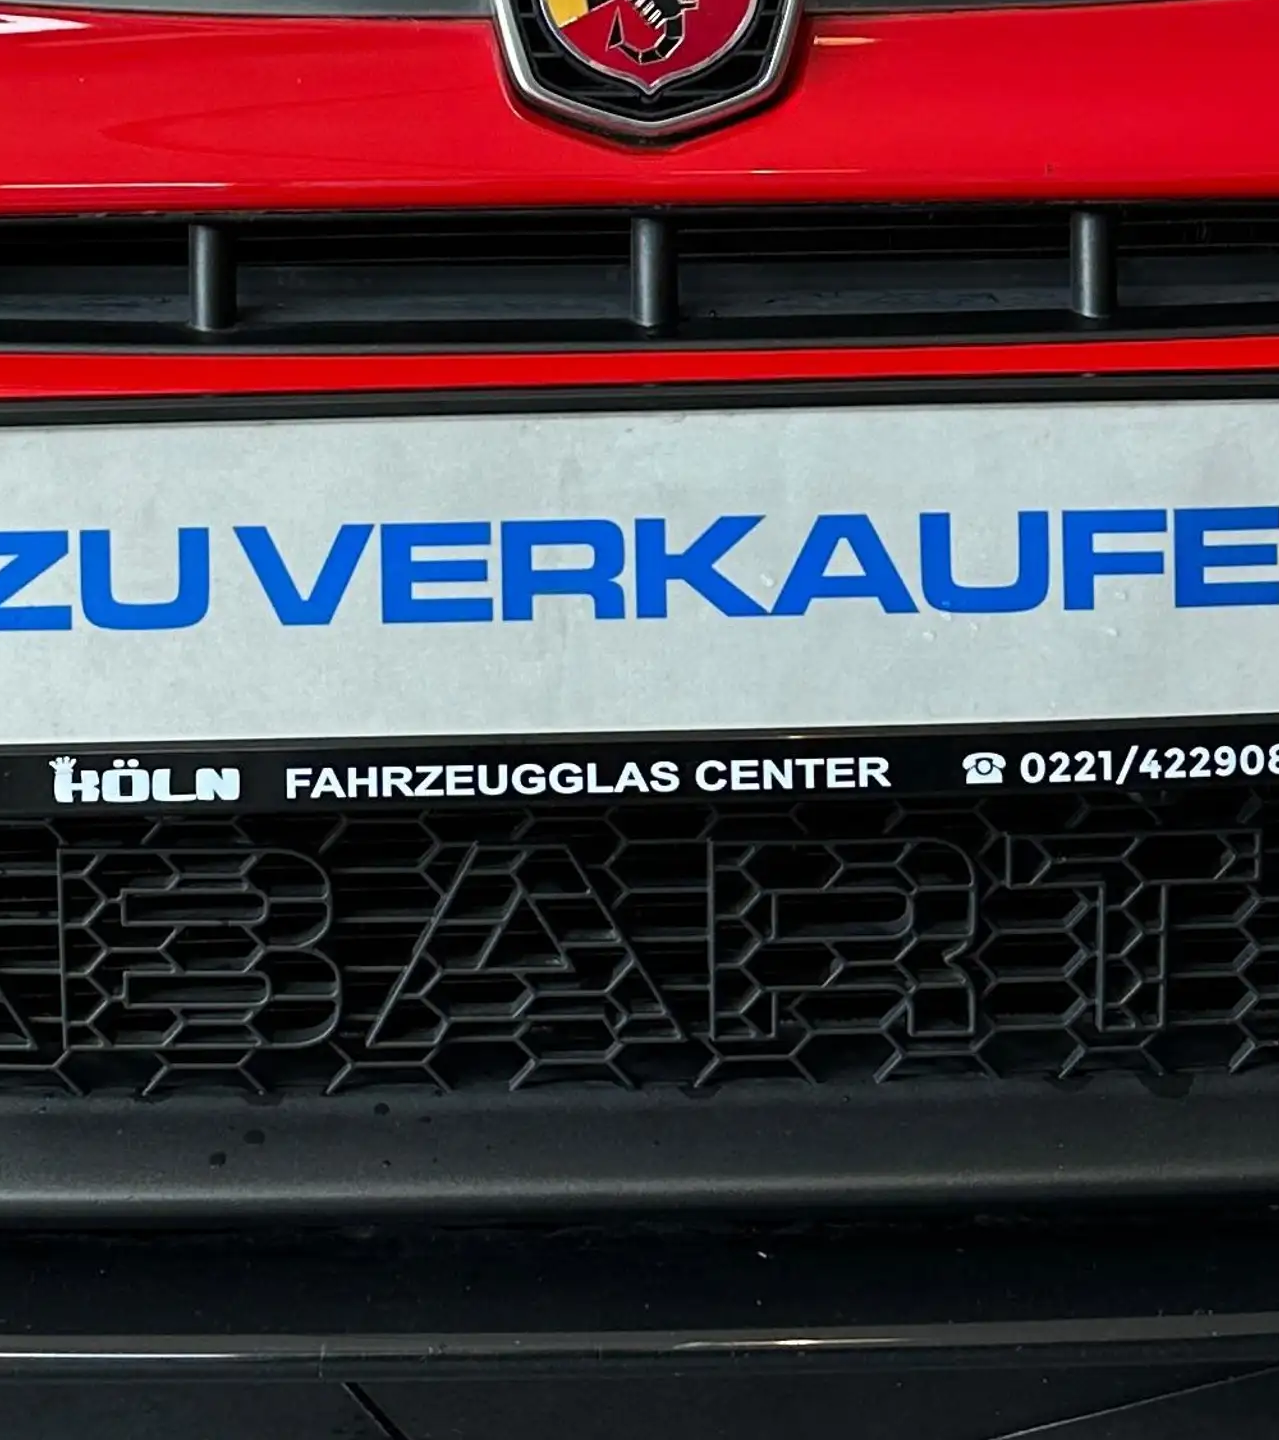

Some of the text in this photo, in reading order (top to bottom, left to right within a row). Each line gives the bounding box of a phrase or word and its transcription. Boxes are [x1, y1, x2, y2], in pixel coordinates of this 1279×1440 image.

[49, 756, 241, 803] KÖLN
[285, 759, 681, 800] FAHRZEUGGLAS
[694, 756, 893, 793] CENTER
